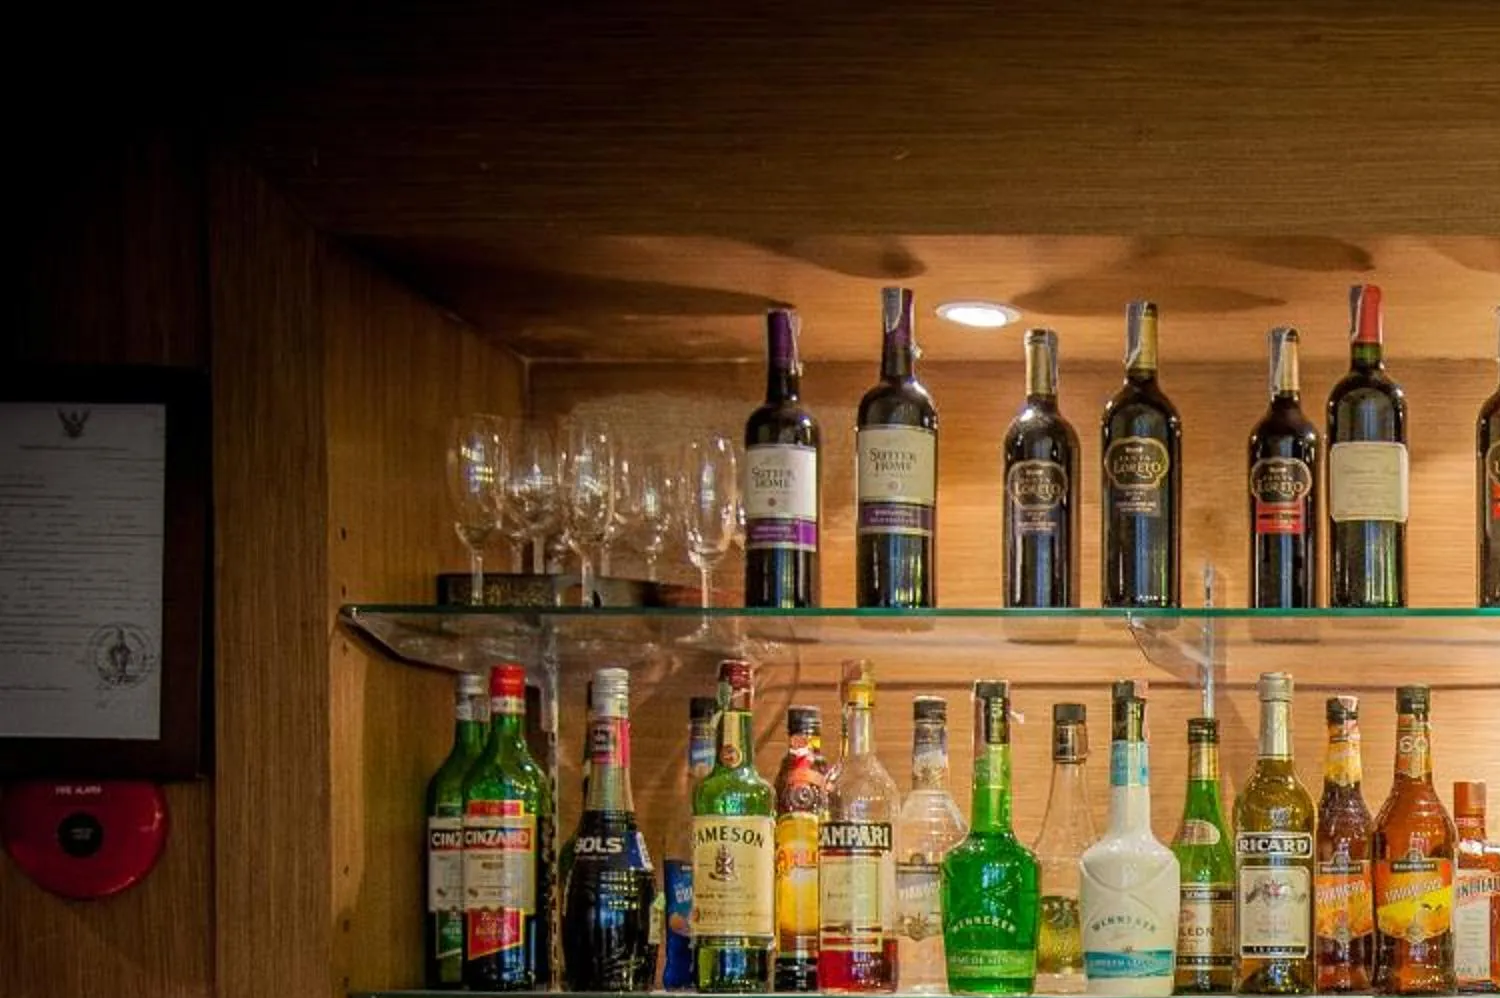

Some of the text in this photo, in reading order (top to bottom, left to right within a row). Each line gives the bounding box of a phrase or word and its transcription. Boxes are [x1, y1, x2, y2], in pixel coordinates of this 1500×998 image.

[465, 829, 529, 846] CINZANO
[820, 825, 889, 847] AMPARI
[1239, 838, 1308, 853] RICARD
